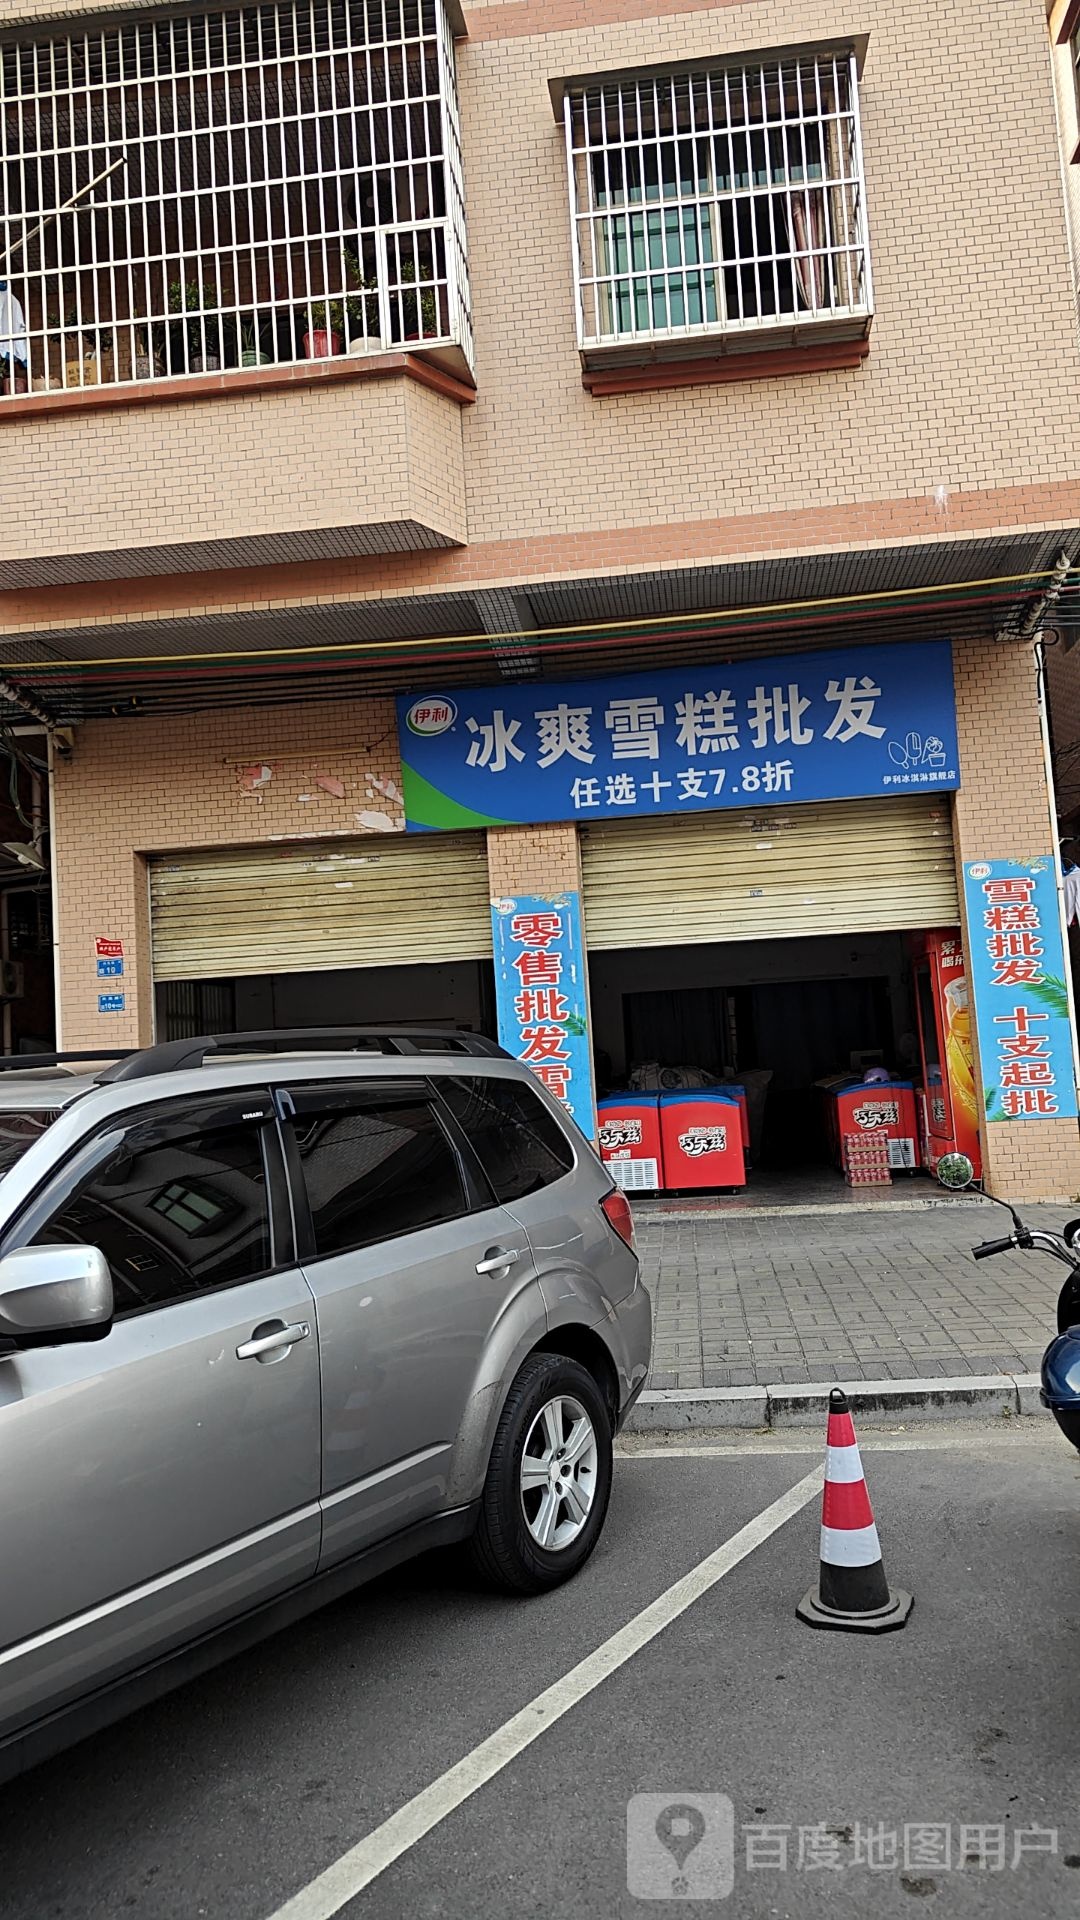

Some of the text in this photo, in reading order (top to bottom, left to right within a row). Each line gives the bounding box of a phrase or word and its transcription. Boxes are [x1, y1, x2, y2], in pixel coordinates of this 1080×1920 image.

[414, 706, 449, 725] 伊利
[465, 676, 888, 772] 冰爽雪糕批发
[570, 760, 795, 809] 任选十支7.8折
[883, 770, 956, 785] 伊利冰淇淋旗舰店
[511, 911, 574, 1114] 零售批发雪
[982, 877, 1059, 1116] 雪糕批发 十支起批
[853, 1107, 899, 1130] 巧乐兹
[680, 1133, 726, 1157] 巧乐兹
